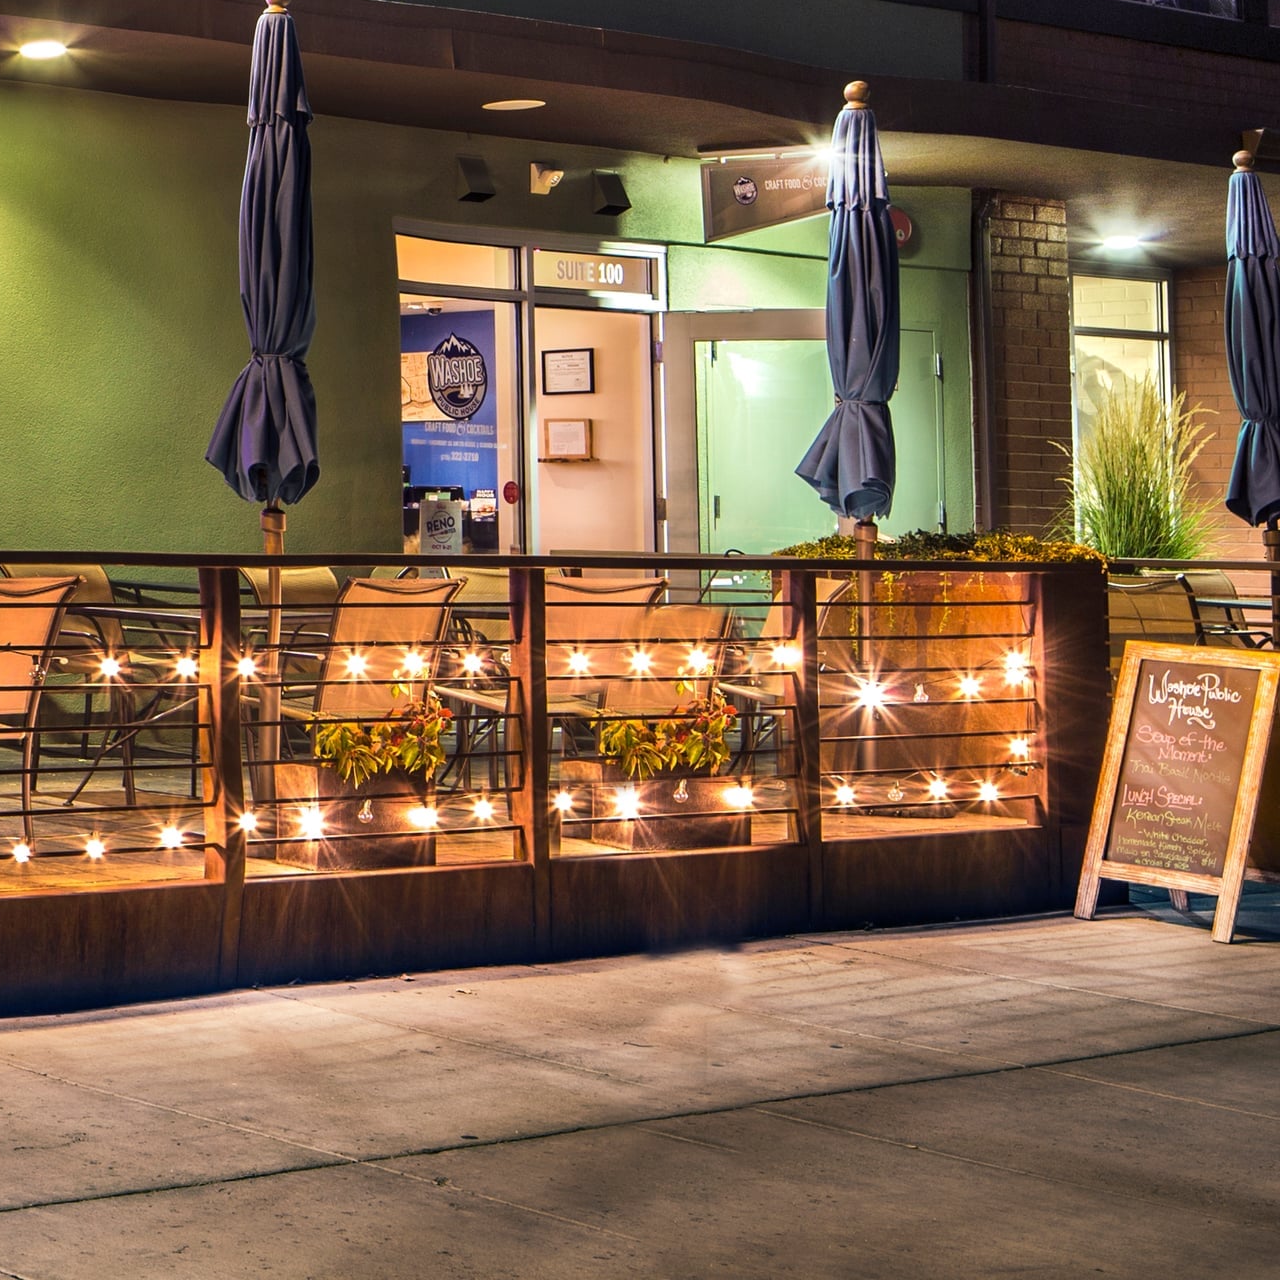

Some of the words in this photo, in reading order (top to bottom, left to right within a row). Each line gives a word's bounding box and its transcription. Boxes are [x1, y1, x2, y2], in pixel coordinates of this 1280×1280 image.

[764, 177, 784, 191] CRAFT
[785, 176, 802, 190] FOOD
[557, 260, 595, 283] SUITE
[598, 262, 624, 285] 100
[430, 358, 483, 389] WASHOE
[438, 396, 459, 416] PUBLIC
[460, 399, 481, 416] HOUSE
[424, 421, 442, 433] CRAFT
[442, 422, 457, 434] FOOD
[426, 516, 455, 533] RENO
[1148, 670, 1202, 705] Washoe
[1196, 672, 1242, 706] Public
[1168, 698, 1214, 726] House
[1136, 725, 1176, 749] Soup
[1178, 731, 1197, 746] of
[1198, 734, 1228, 752] the
[1130, 759, 1154, 774] Thai
[1126, 808, 1165, 829] Korean
[1192, 813, 1222, 836] Melt
